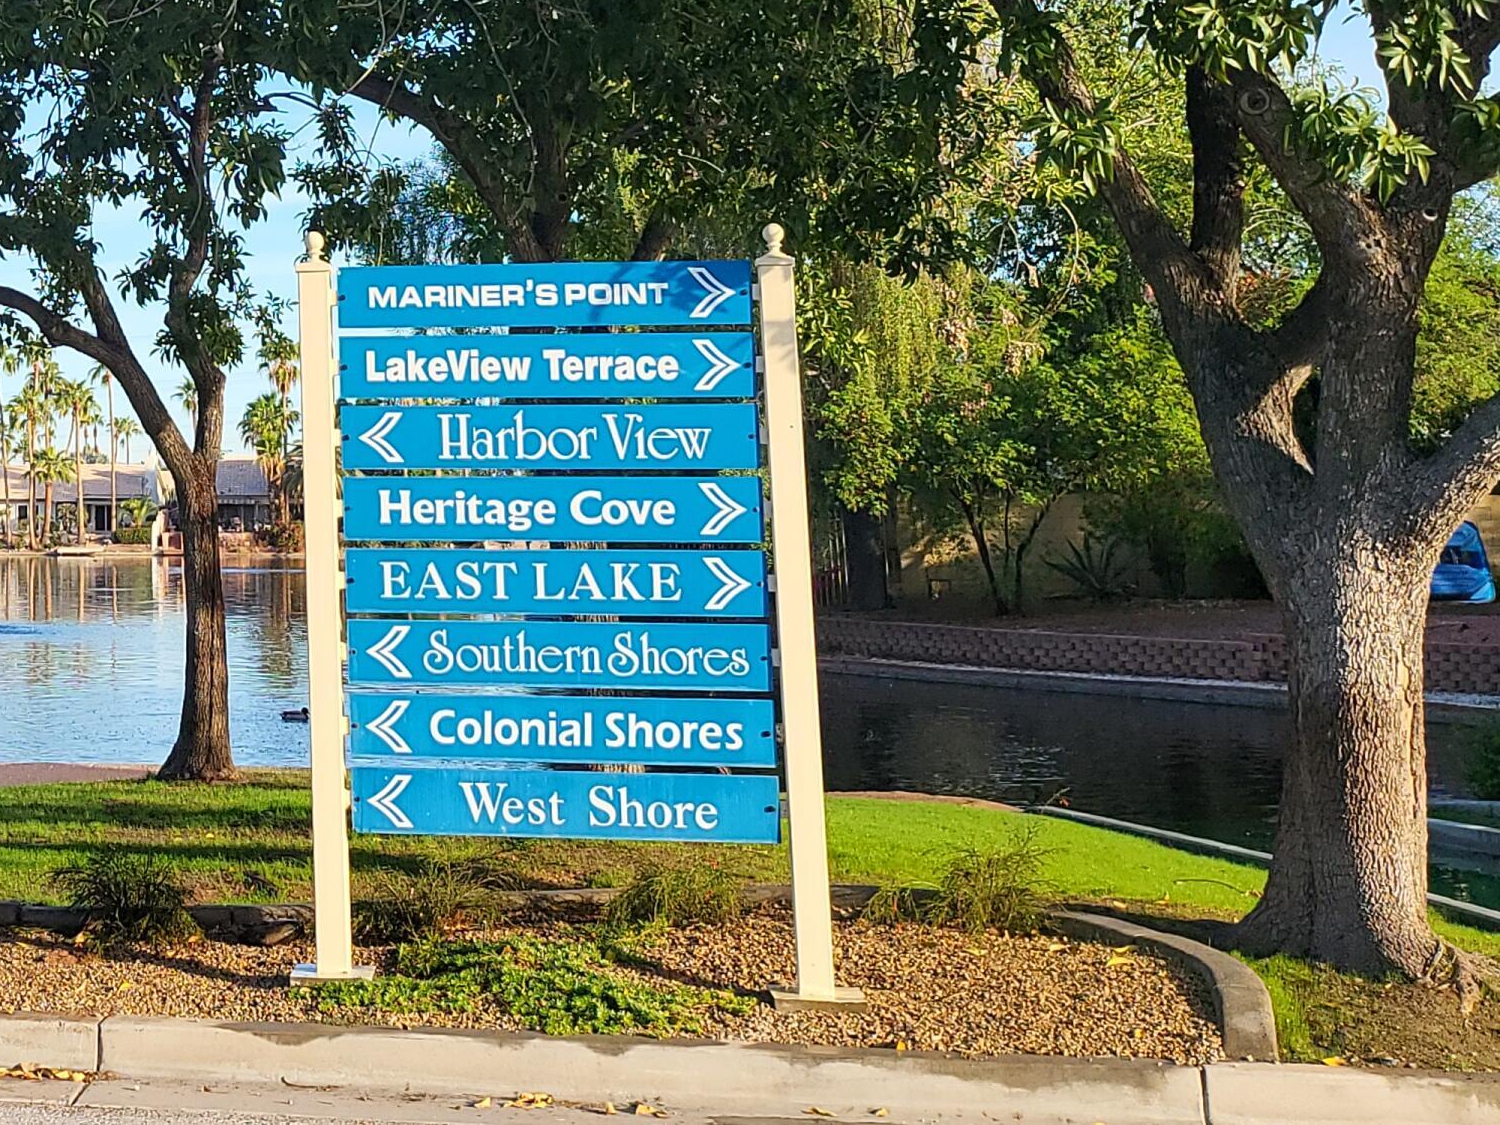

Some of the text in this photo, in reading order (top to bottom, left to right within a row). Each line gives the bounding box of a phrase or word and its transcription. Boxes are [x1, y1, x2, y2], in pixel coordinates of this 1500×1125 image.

[368, 279, 668, 308] MARINER'S POINT
[366, 349, 679, 382] LakeView Terrace
[438, 410, 712, 459] Harbor View
[379, 489, 675, 531] Heritage Cove
[380, 561, 682, 601] EAST LAKE
[422, 629, 750, 676] Southern Shores
[430, 709, 743, 750] Colonial Shores
[459, 782, 718, 829] West Shore
